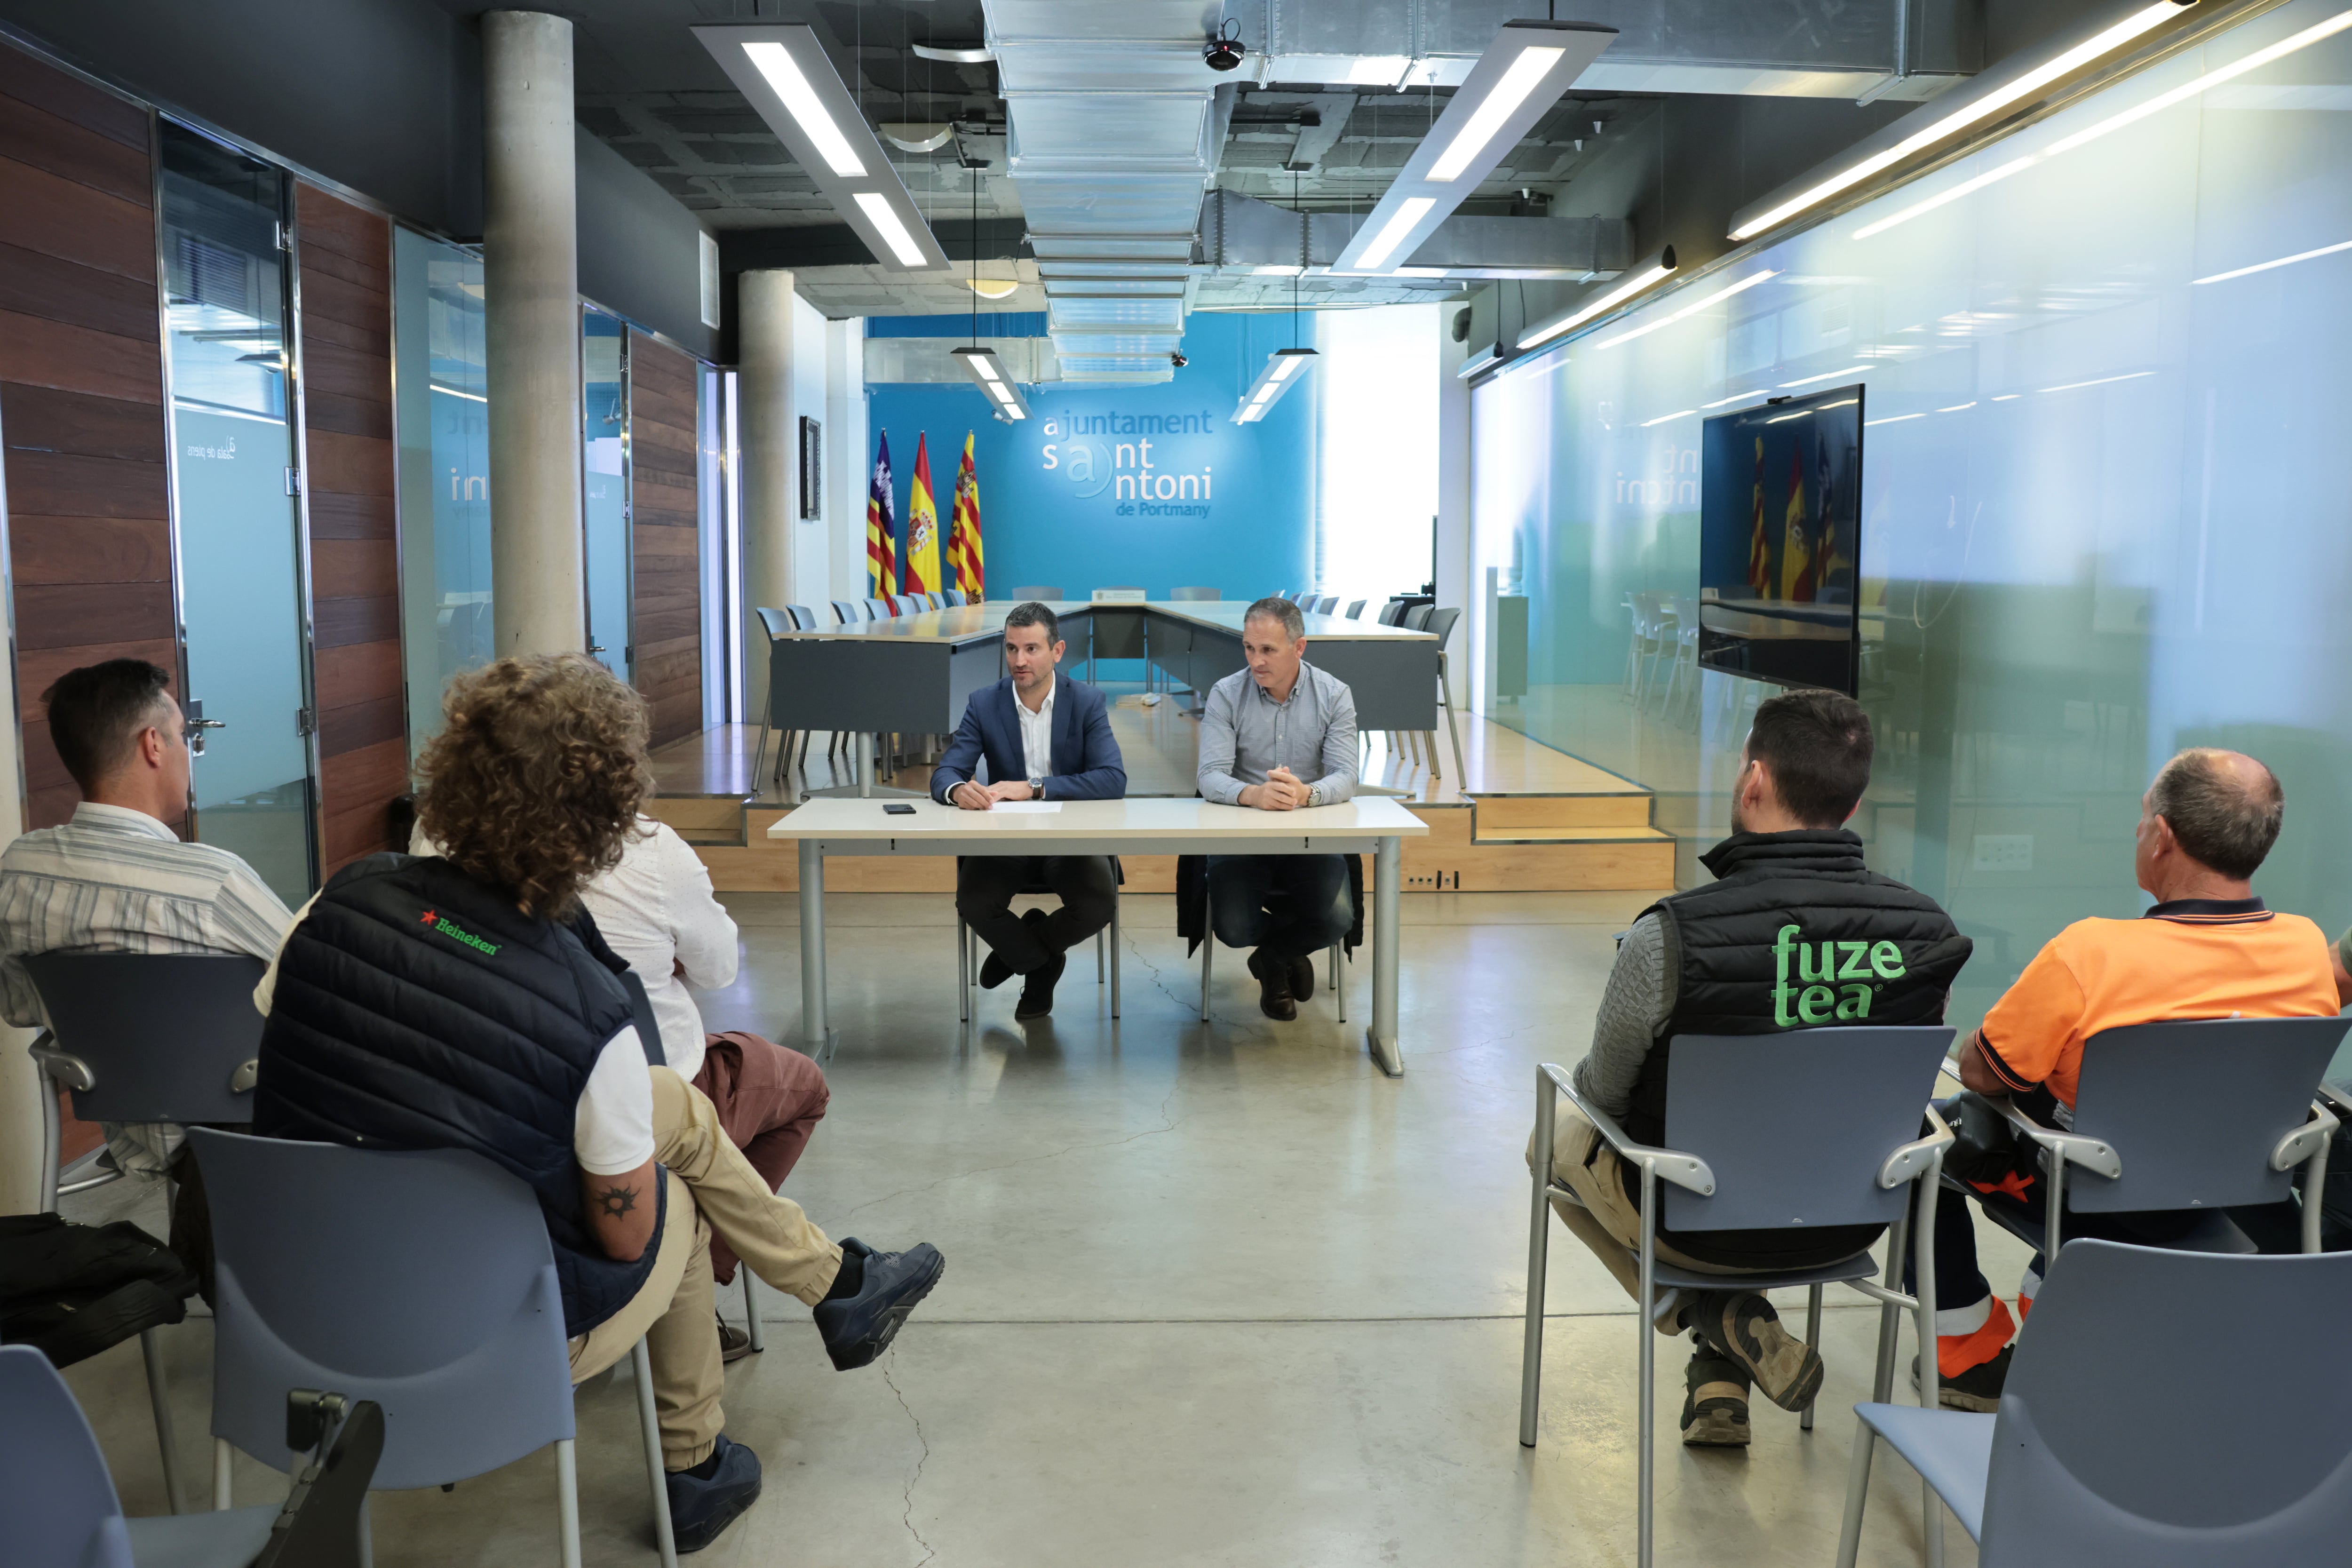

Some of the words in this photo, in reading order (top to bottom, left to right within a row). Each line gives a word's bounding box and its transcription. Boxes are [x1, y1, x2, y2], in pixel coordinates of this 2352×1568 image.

[1043, 410, 1213, 442] ajuntament
[1115, 502, 1134, 516] de
[1139, 502, 1211, 519] Portmany
[435, 917, 498, 955] Heineken
[1771, 924, 1907, 983] fuze
